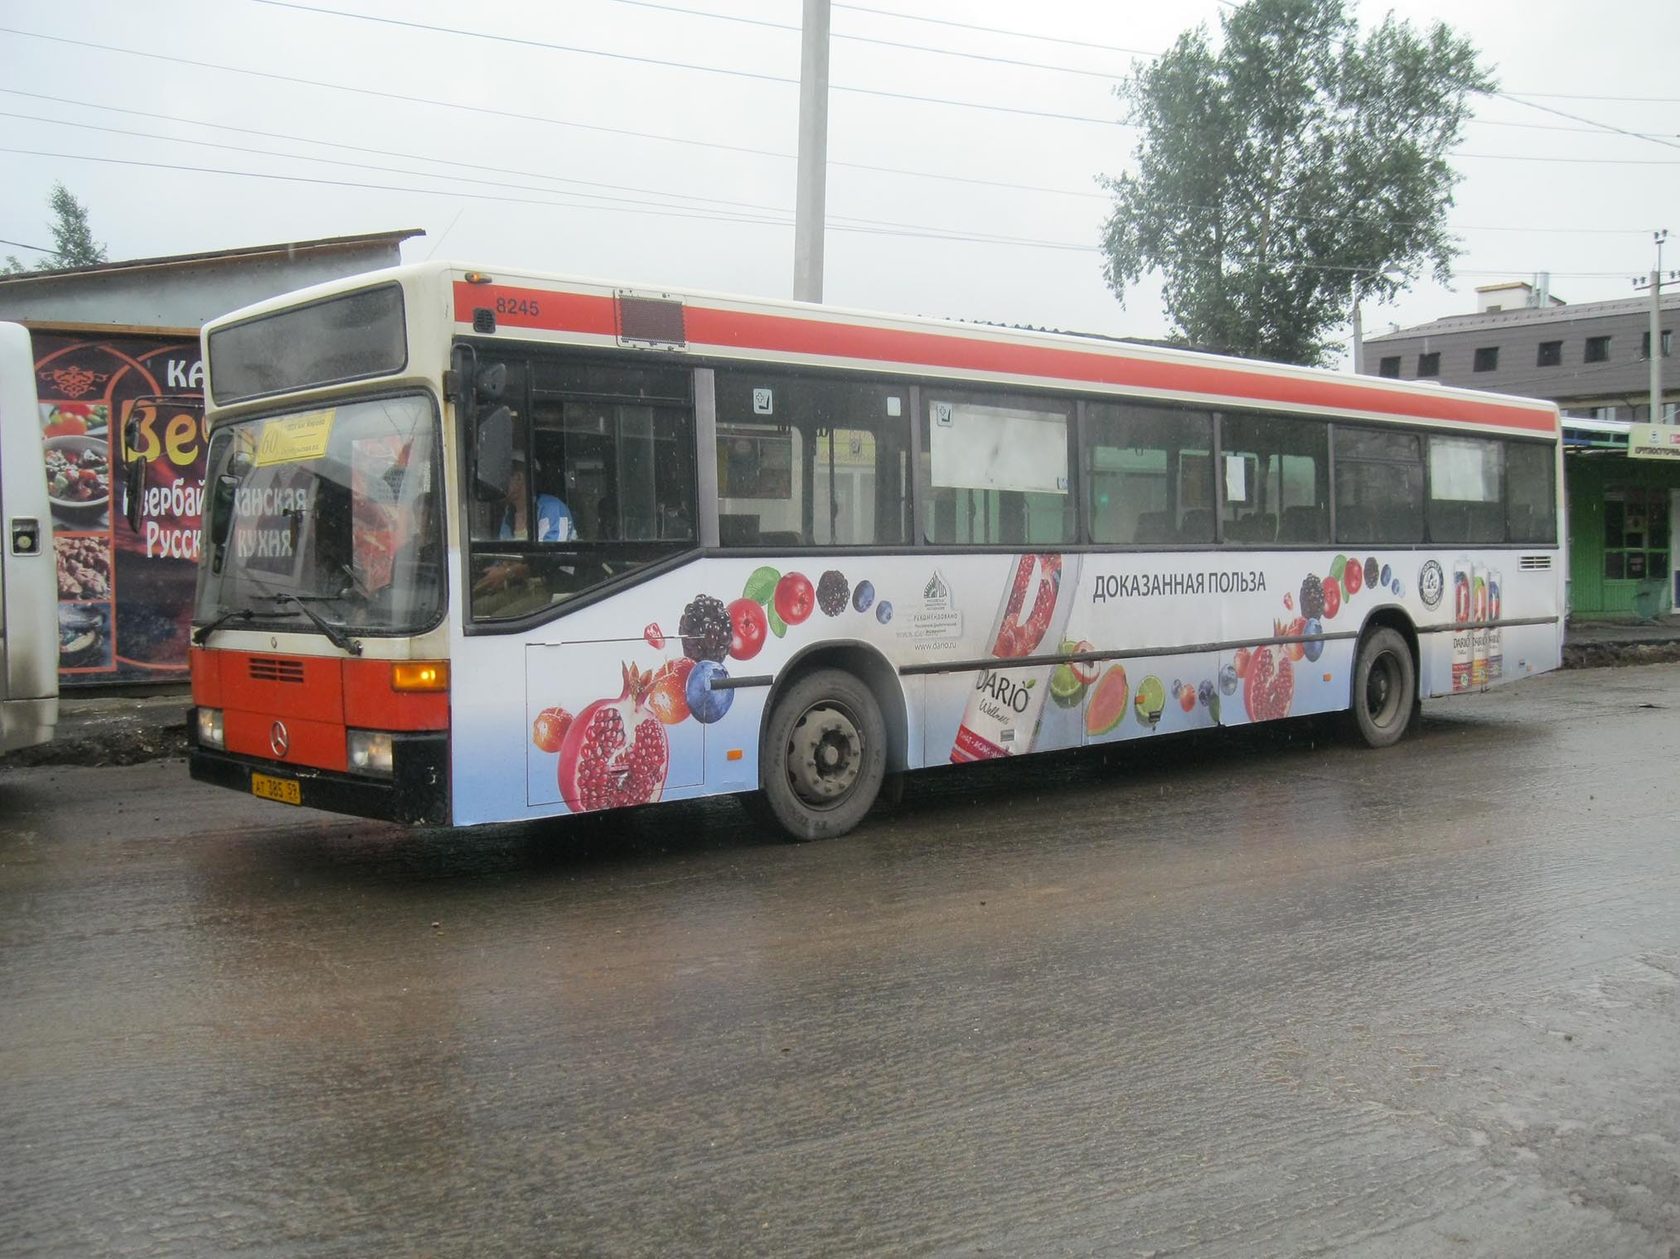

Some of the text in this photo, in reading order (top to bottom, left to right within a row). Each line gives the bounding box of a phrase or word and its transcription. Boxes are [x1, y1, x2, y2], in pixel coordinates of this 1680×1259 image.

[496, 296, 540, 317] 8245
[167, 359, 205, 388] КА
[146, 520, 206, 560] Русск
[1093, 571, 1266, 603] ДОКАЗАННАЯ ПОЛЬЗА
